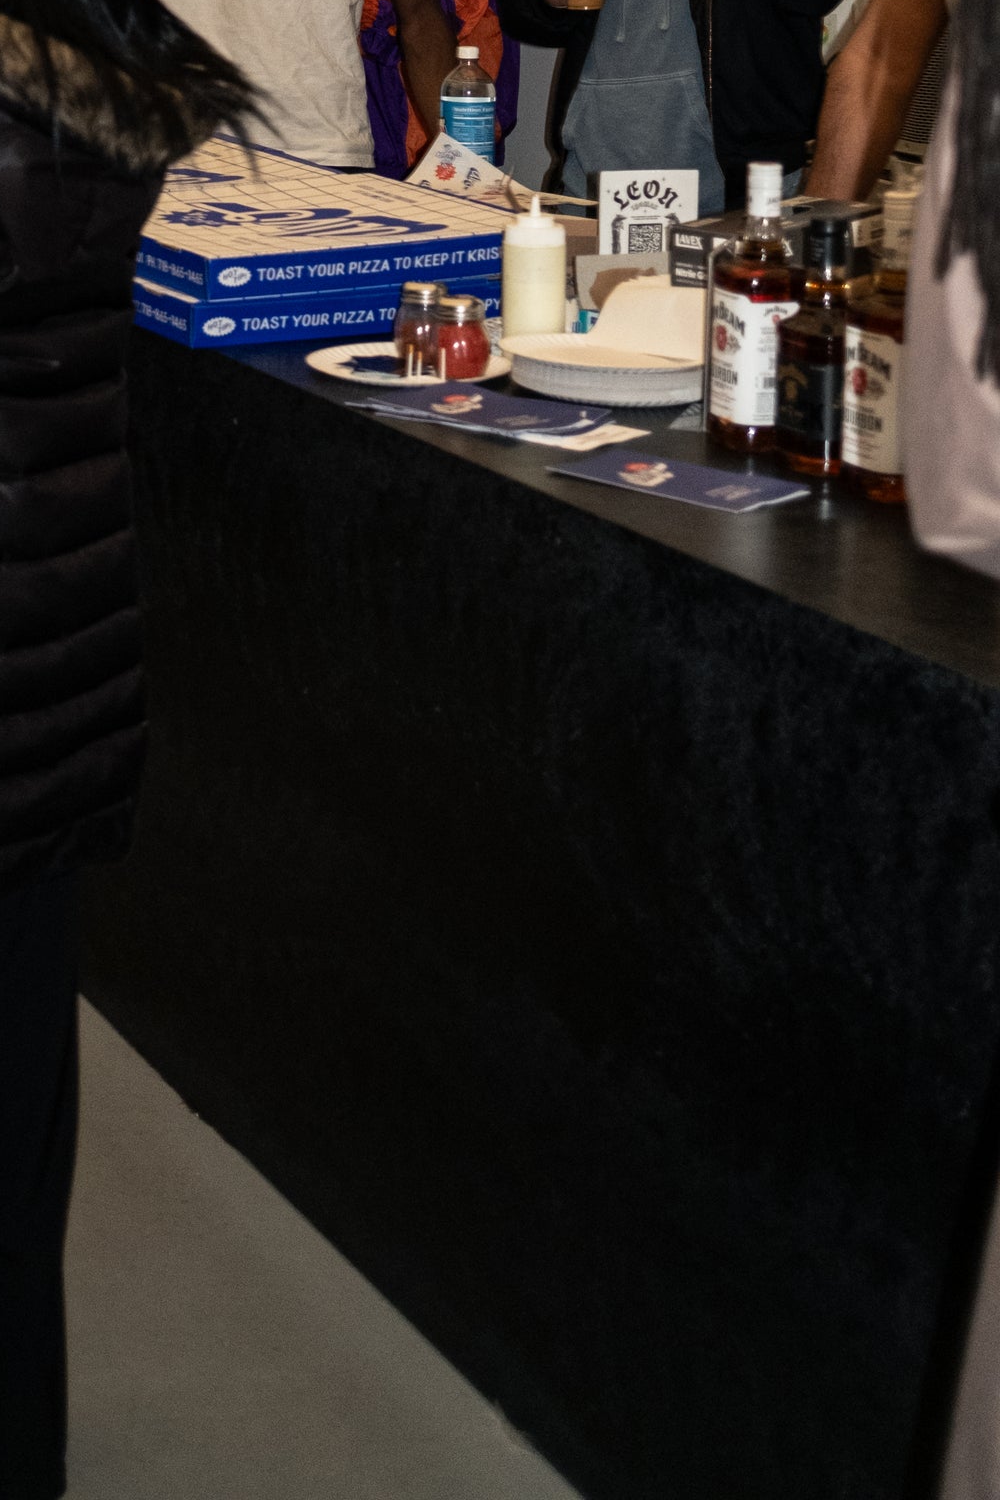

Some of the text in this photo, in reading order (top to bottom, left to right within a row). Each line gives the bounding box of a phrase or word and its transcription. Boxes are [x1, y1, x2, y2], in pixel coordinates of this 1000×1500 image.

[614, 180, 678, 210] LEON
[257, 247, 499, 282] TOAST YOUR PIZZA TO KEEP IT KRIS
[242, 307, 396, 331] TOAST YOUR PIZZA TO
